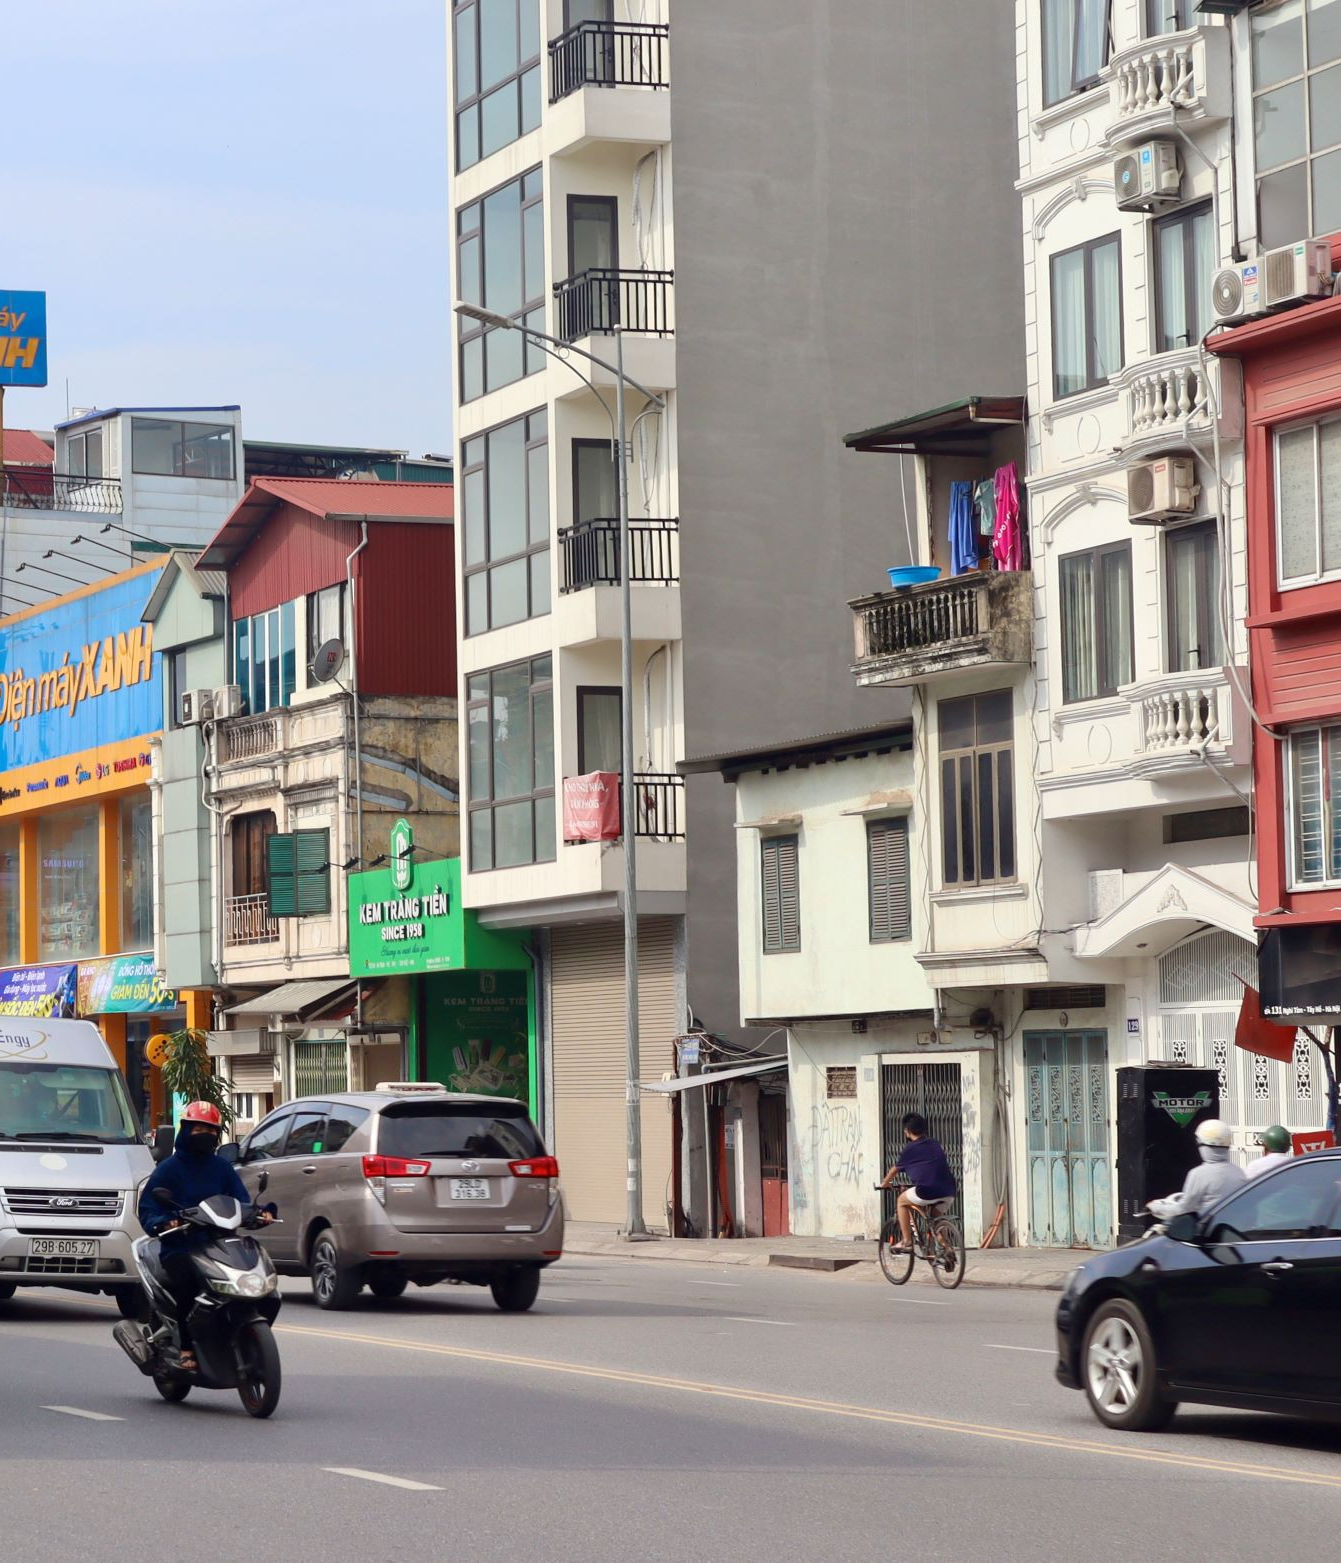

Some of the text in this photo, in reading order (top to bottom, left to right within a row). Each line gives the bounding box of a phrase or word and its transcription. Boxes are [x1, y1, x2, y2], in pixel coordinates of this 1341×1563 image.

[359, 884, 448, 924] KEM TRÀNG TIỀN
[381, 923, 423, 941] SINCE 1958
[1271, 1005, 1282, 1015] 131
[1158, 1098, 1204, 1107] MOTOR
[56, 1197, 74, 1207] Ford
